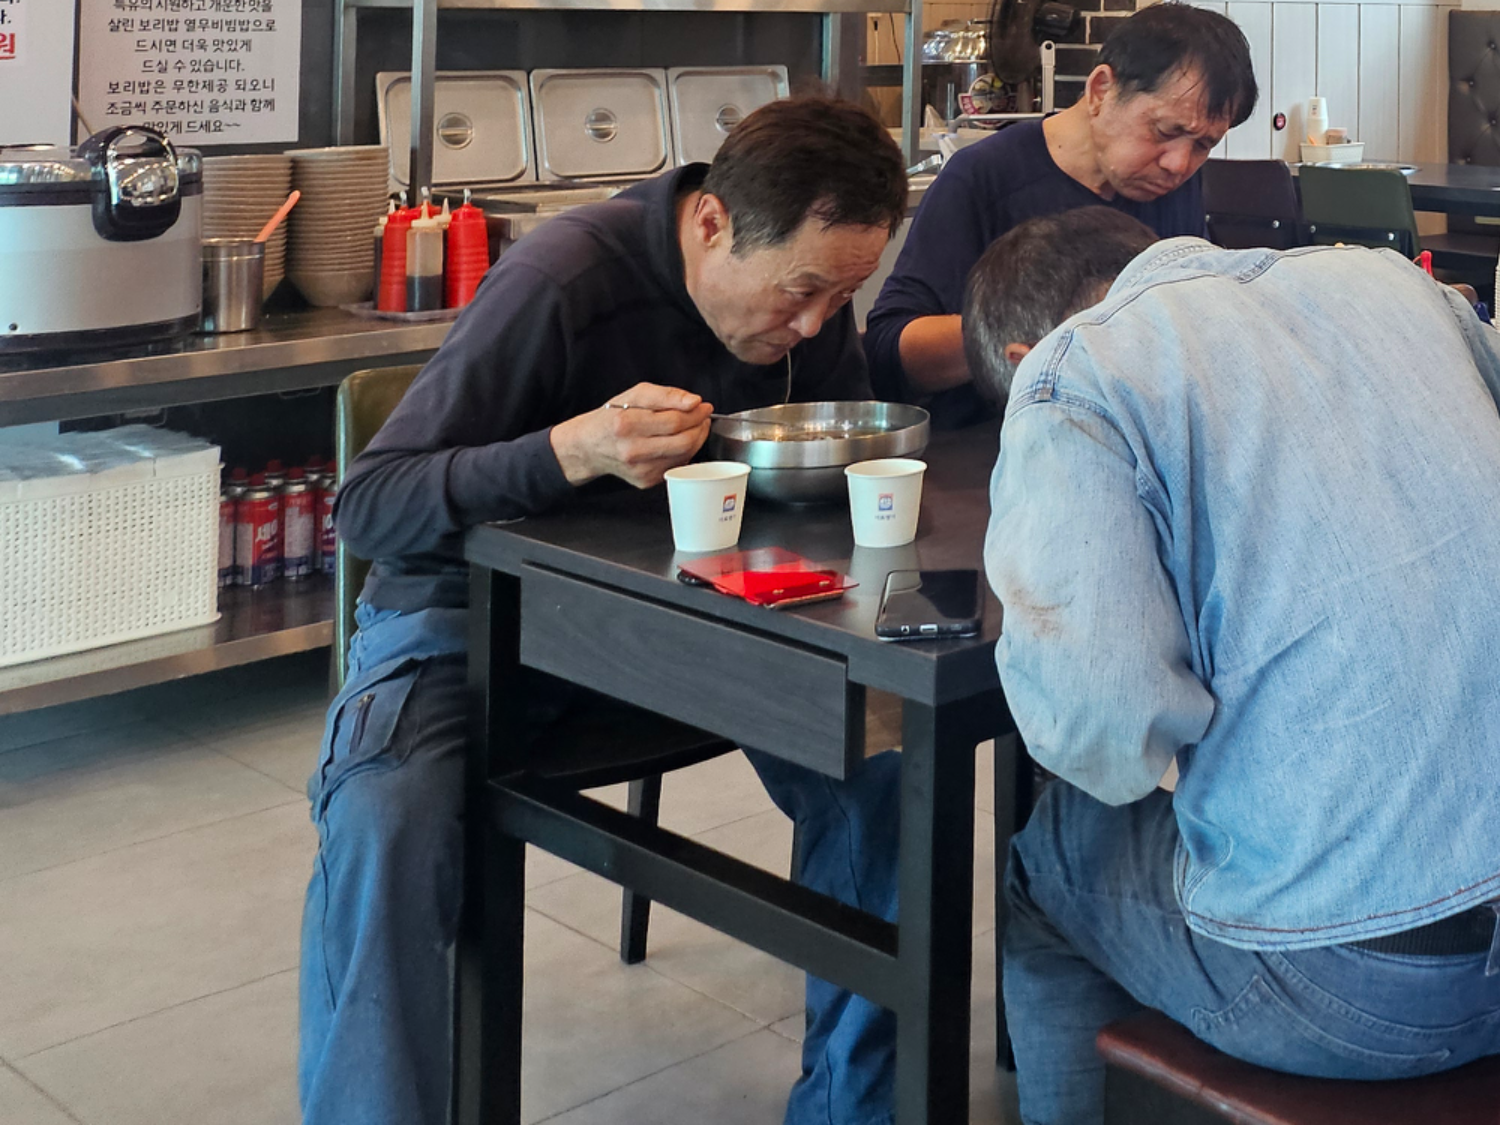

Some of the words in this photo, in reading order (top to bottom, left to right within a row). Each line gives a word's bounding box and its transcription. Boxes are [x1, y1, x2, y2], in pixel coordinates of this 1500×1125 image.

[107, 18, 135, 33] 살린
[137, 18, 180, 33] 보리밥
[183, 18, 277, 33] 열무비빔밥으로
[134, 38, 177, 53] 드시면
[181, 39, 209, 53] 더욱
[212, 38, 253, 53] 맛있게
[141, 59, 168, 74] 드실
[172, 59, 187, 73] 수
[189, 59, 246, 73] 있습니다.
[107, 79, 167, 95] 보리밥은
[172, 78, 229, 94] 무한제공
[234, 77, 276, 93] 되오니
[105, 100, 147, 116] 조금씩
[150, 99, 204, 115] 주문하신
[207, 98, 247, 114] 음식과
[250, 97, 276, 113] 함께
